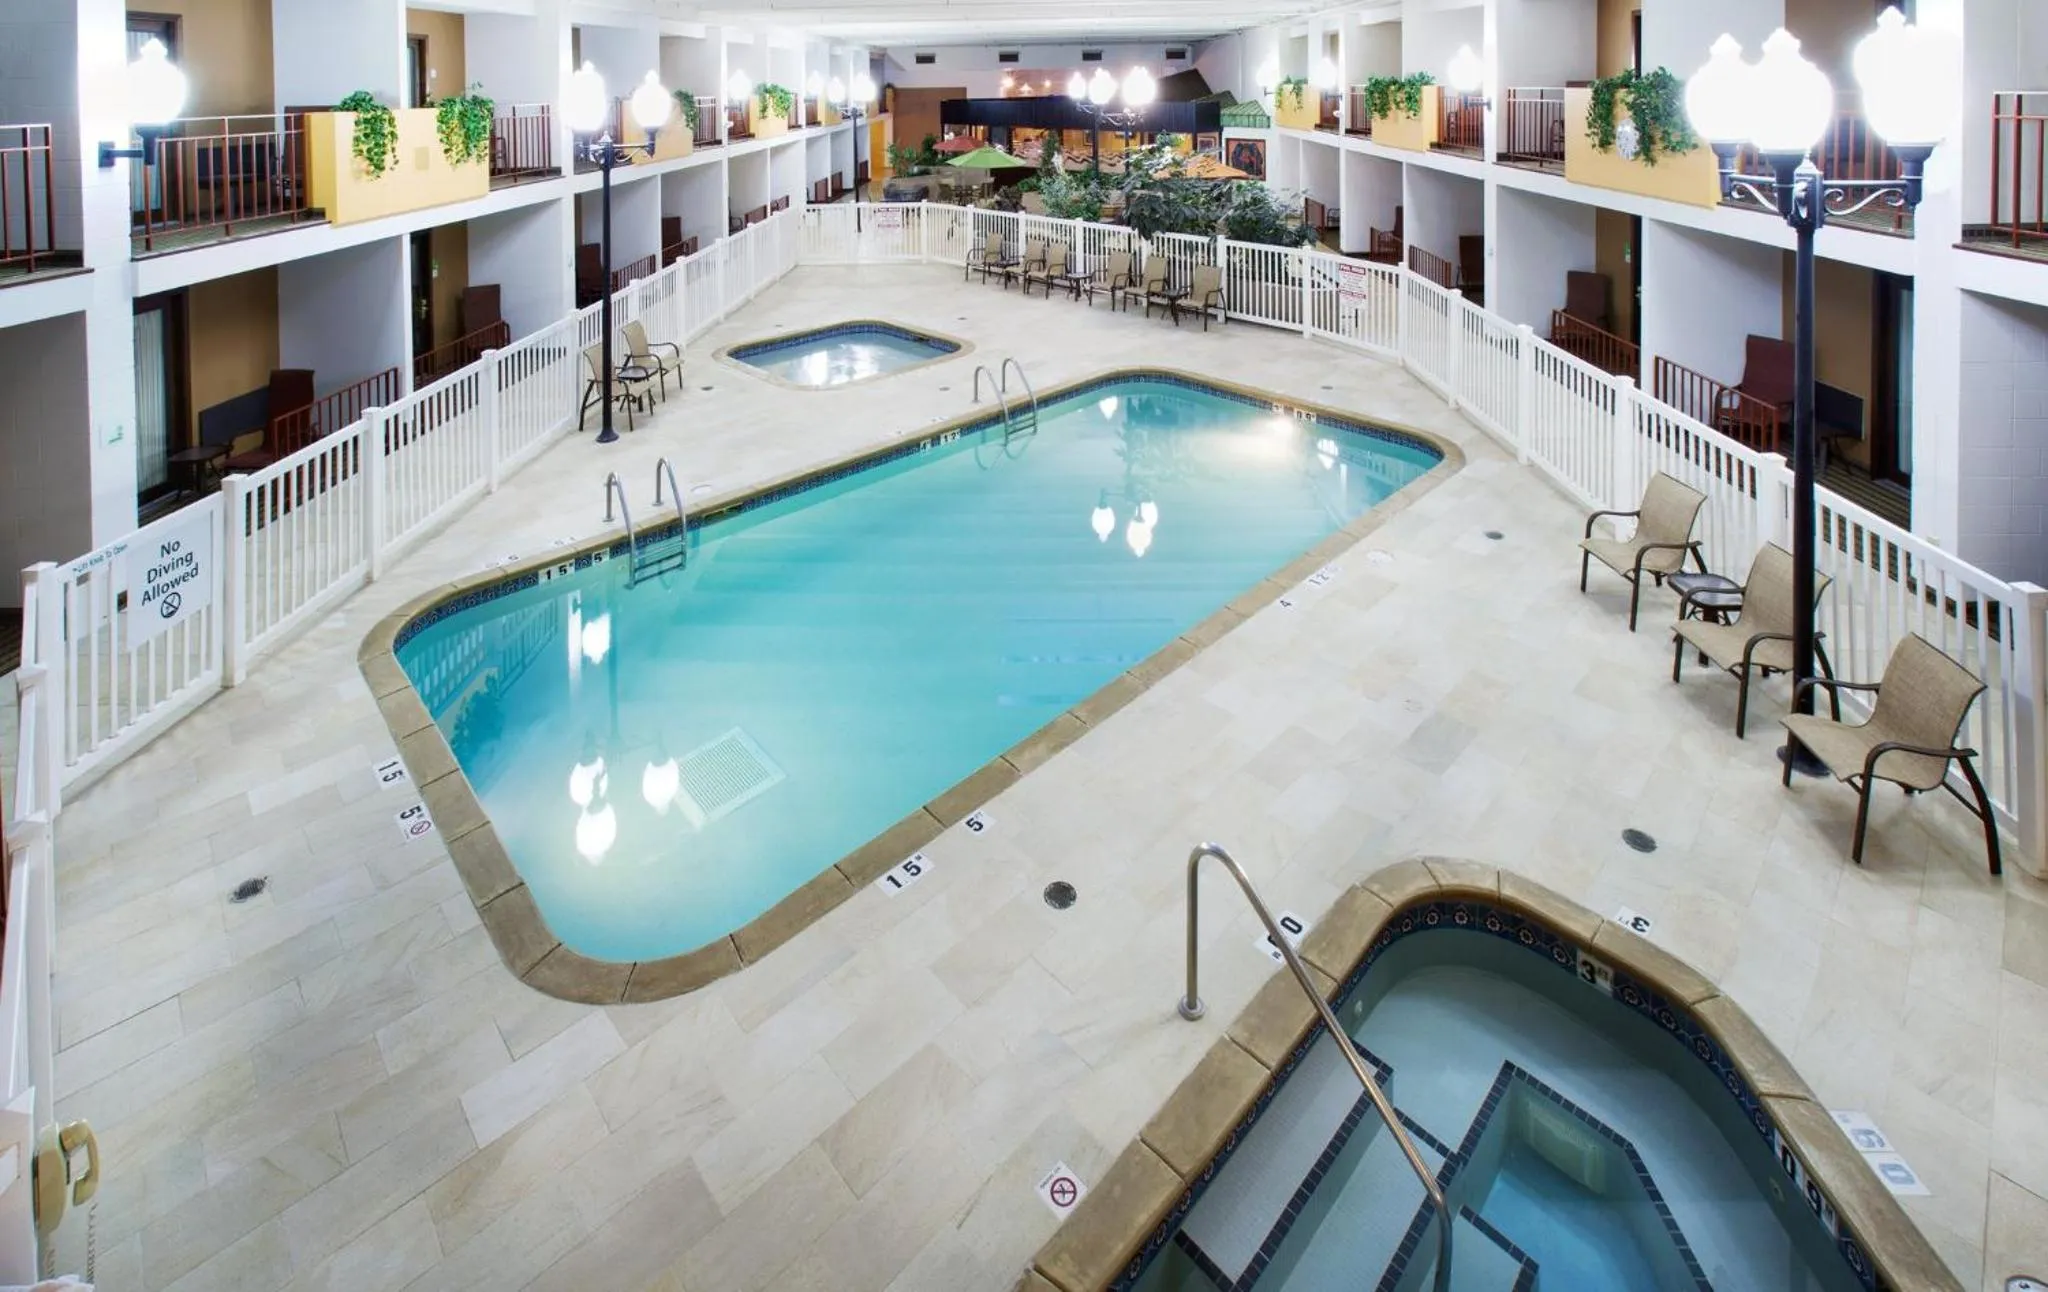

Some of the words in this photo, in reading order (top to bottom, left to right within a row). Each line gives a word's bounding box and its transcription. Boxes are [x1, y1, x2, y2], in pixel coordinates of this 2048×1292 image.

[161, 540, 180, 558] No
[147, 551, 193, 584] Diving
[142, 562, 199, 607] Allowed
